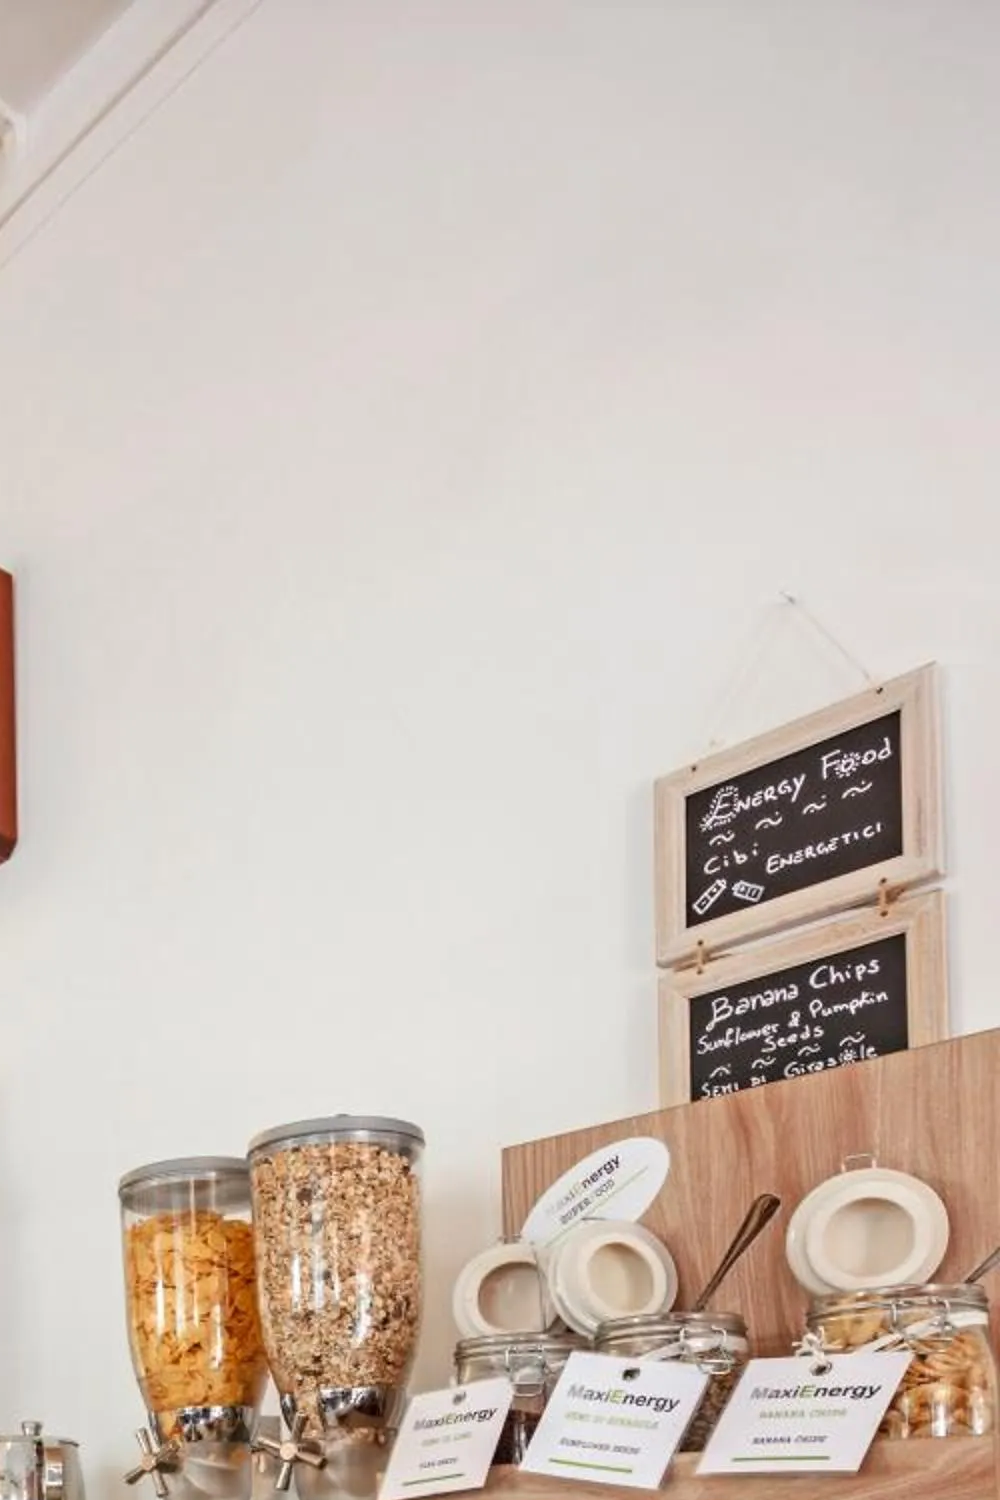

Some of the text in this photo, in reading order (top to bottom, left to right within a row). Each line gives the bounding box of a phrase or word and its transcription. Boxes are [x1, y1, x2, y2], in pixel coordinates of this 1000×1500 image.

[820, 737, 893, 780] Food
[703, 843, 760, 875] Cibi
[705, 958, 881, 1033] Banana Chips
[696, 990, 889, 1056] Sunflower & Pumpkin
[760, 1024, 825, 1054] Seeds
[567, 1383, 681, 1413] MaxiEnergy
[749, 1383, 882, 1401] MaxiEnergy
[413, 1407, 499, 1431] MaxiEnergy
